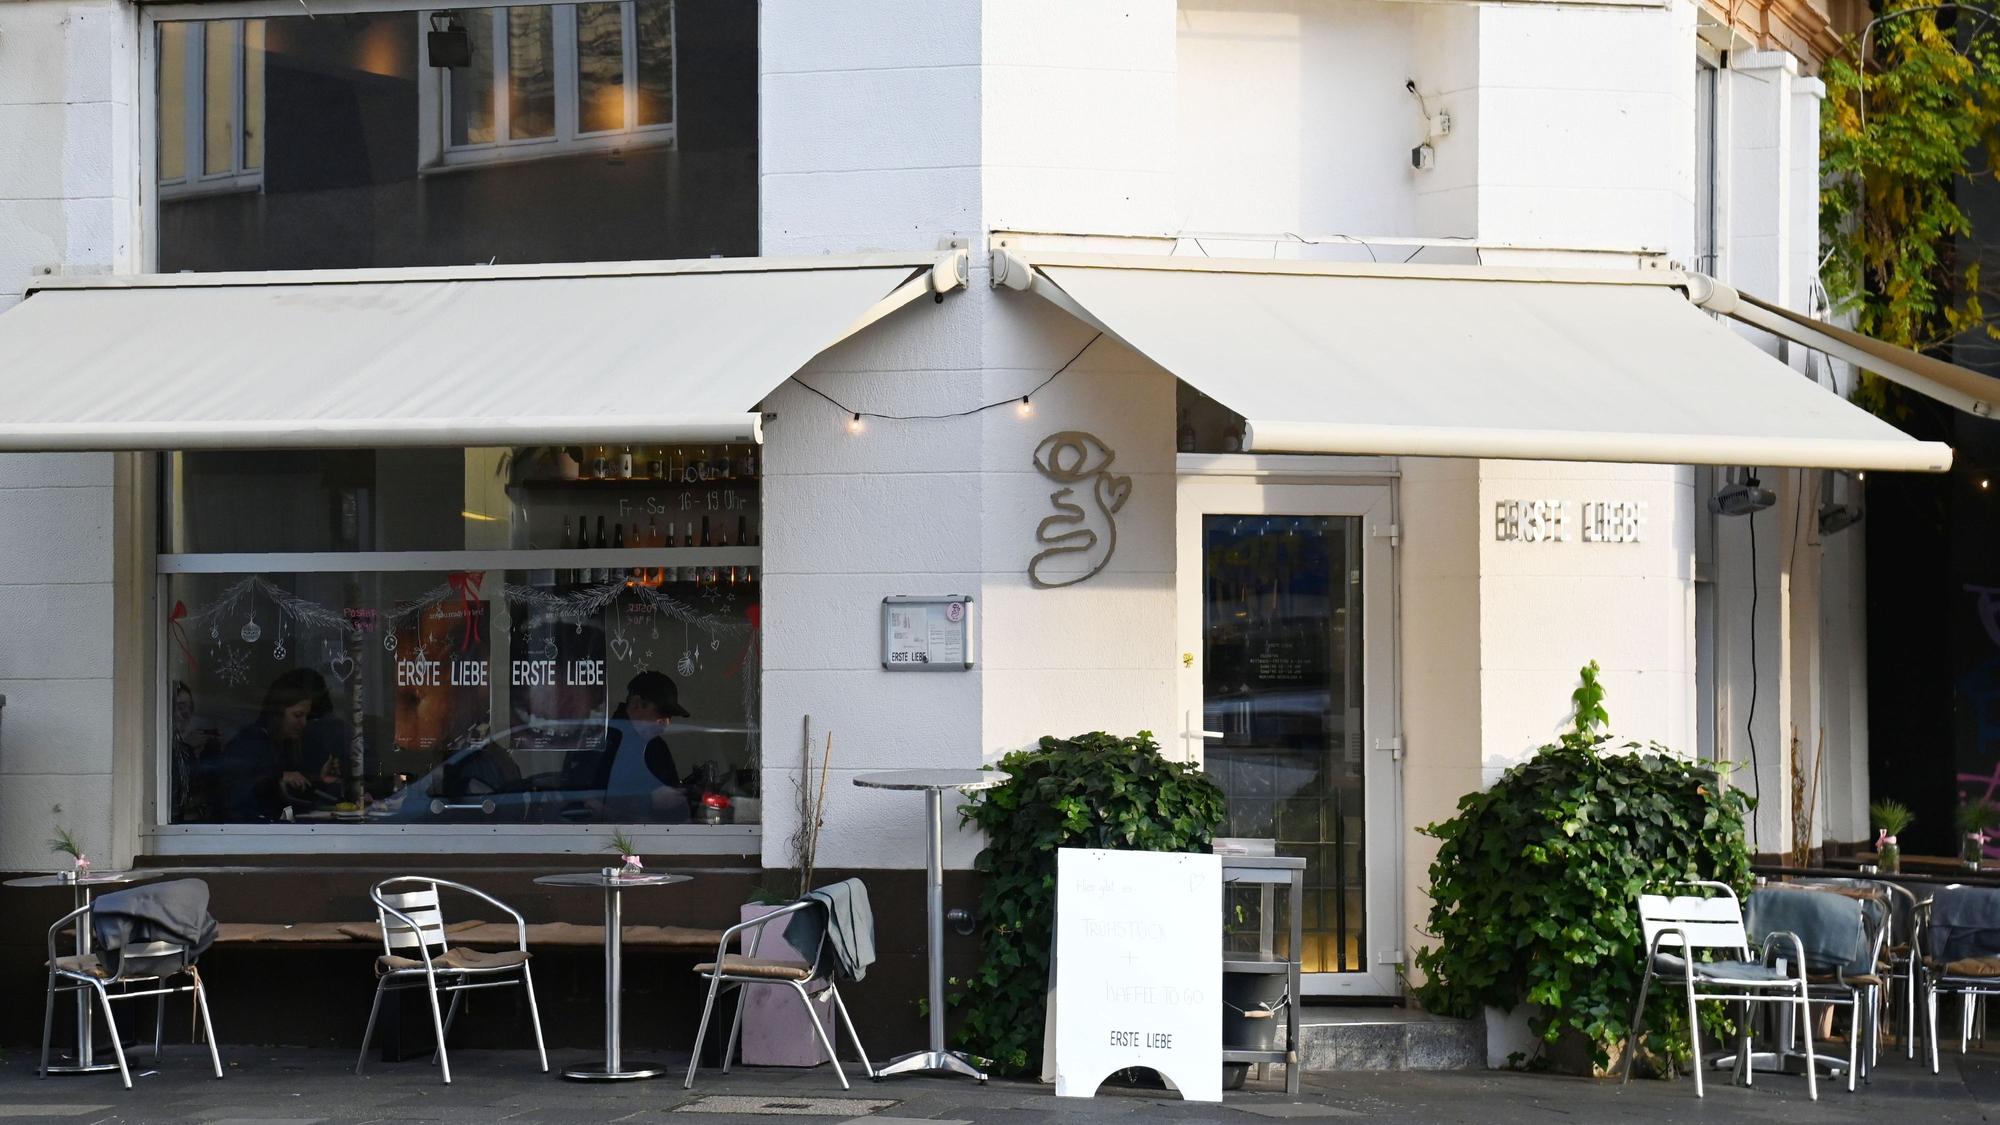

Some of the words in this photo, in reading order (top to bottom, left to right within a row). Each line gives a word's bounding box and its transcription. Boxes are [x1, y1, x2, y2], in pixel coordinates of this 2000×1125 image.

[1500, 500, 1571, 542] ERSTE
[1586, 500, 1648, 543] LIEBE
[891, 651, 908, 662] ERSTE
[397, 660, 440, 687] ERSTE
[451, 660, 488, 687] LIEBE
[512, 660, 556, 686] ERSTE
[567, 660, 604, 686] LIEBE
[1110, 1030, 1140, 1047] ERSTE
[1146, 1032, 1173, 1049] LIEBE
